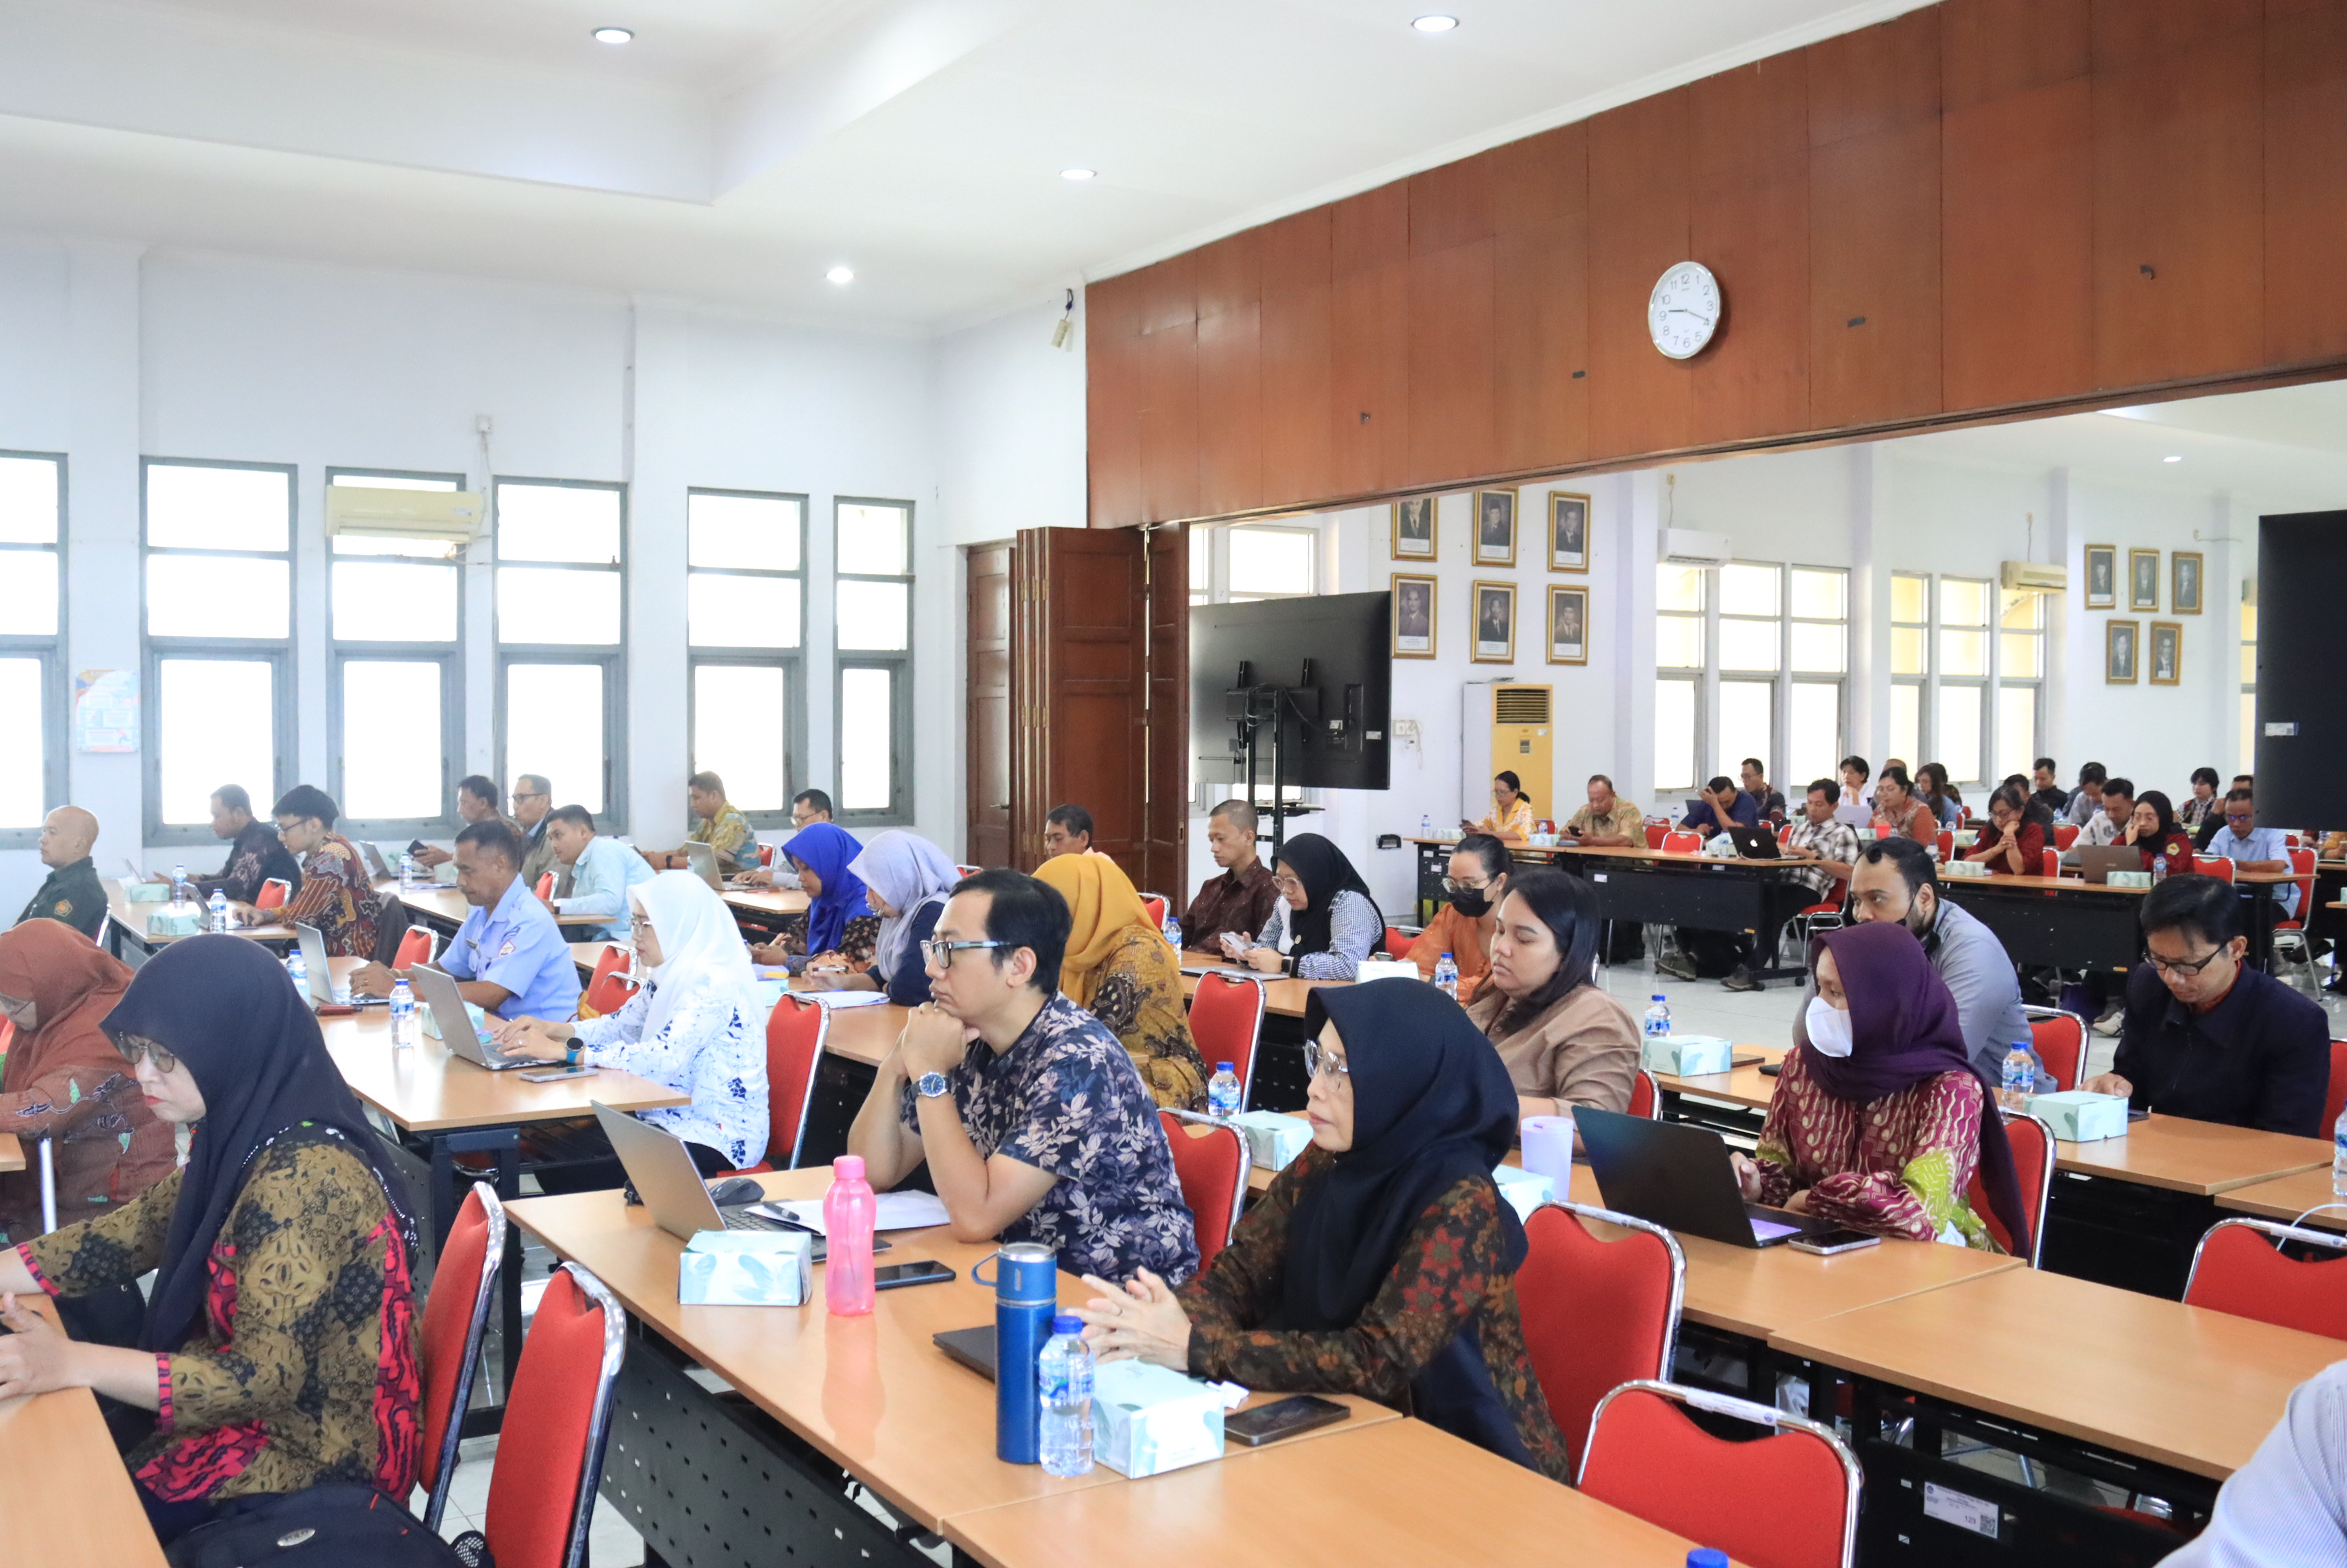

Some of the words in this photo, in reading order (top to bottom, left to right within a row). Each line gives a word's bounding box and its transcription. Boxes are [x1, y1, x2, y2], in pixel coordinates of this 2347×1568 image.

[1681, 274, 1690, 285] 12
[1670, 280, 1677, 291] 11
[1703, 285, 1710, 296] 2
[1662, 295, 1670, 305] 10
[1706, 301, 1714, 312] 3
[1660, 311, 1667, 322] 9
[1703, 317, 1710, 326] 4
[1663, 326, 1670, 336] 8
[1695, 331, 1702, 342] 5
[1673, 336, 1679, 346] 7
[1683, 337, 1691, 348] 6
[1964, 1515, 1976, 1524] 123
